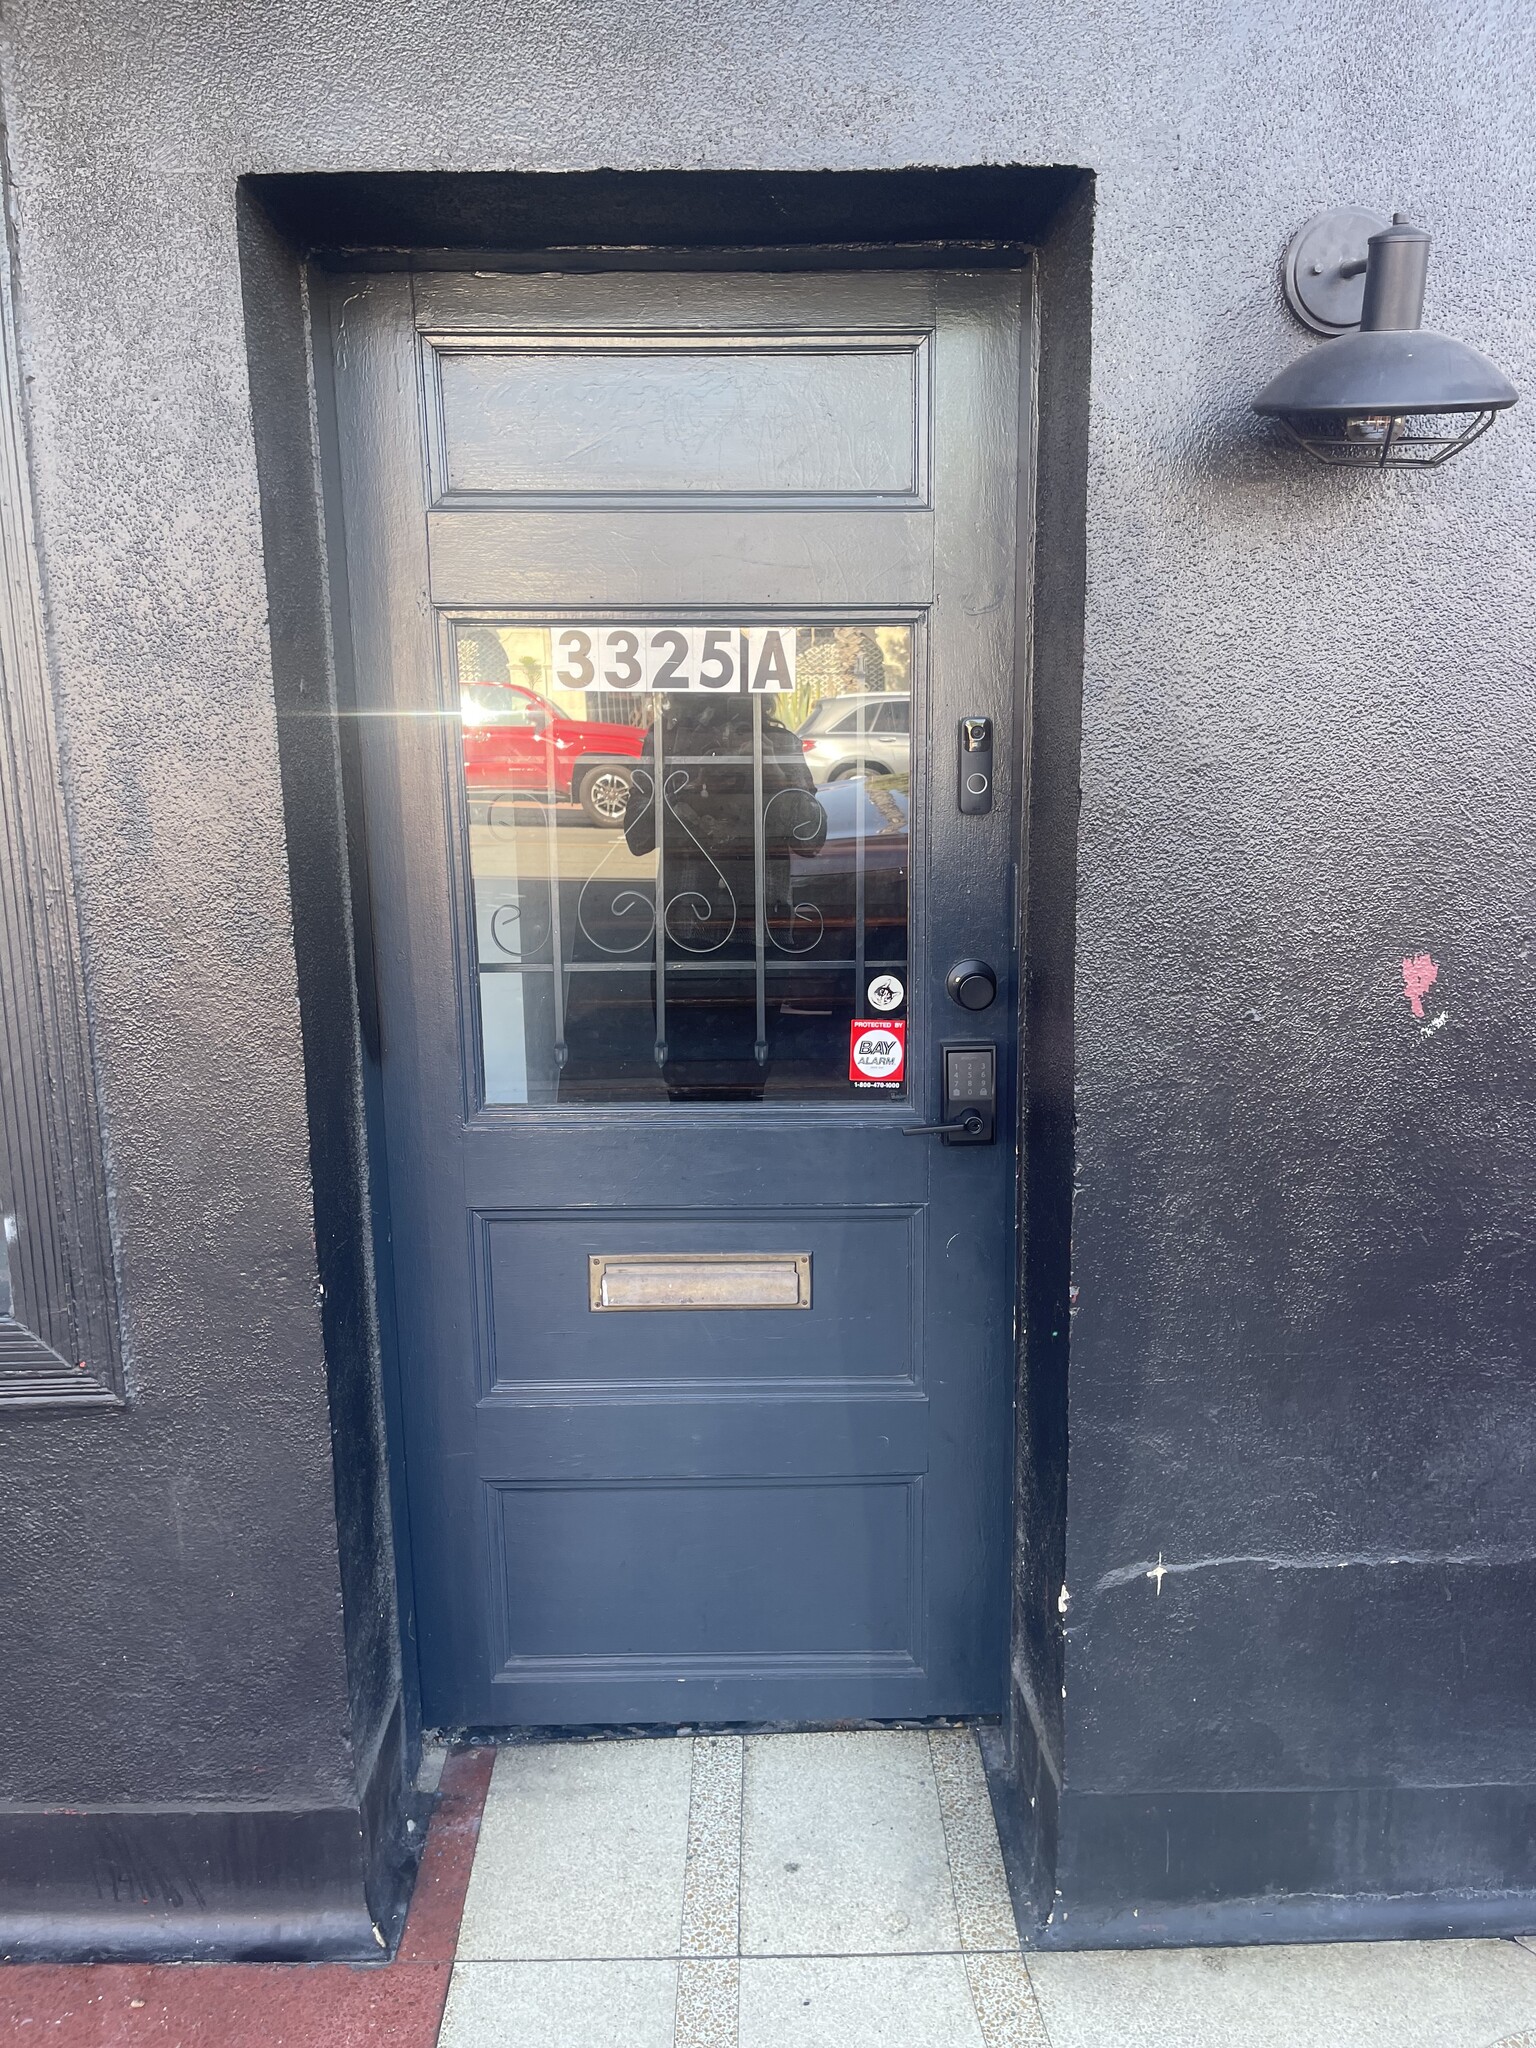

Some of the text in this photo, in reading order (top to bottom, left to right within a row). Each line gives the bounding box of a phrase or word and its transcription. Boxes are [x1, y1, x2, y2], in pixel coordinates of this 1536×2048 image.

[556, 629, 794, 690] 3325 A
[859, 1040, 897, 1055] BAY
[857, 1056, 896, 1066] ALARM
